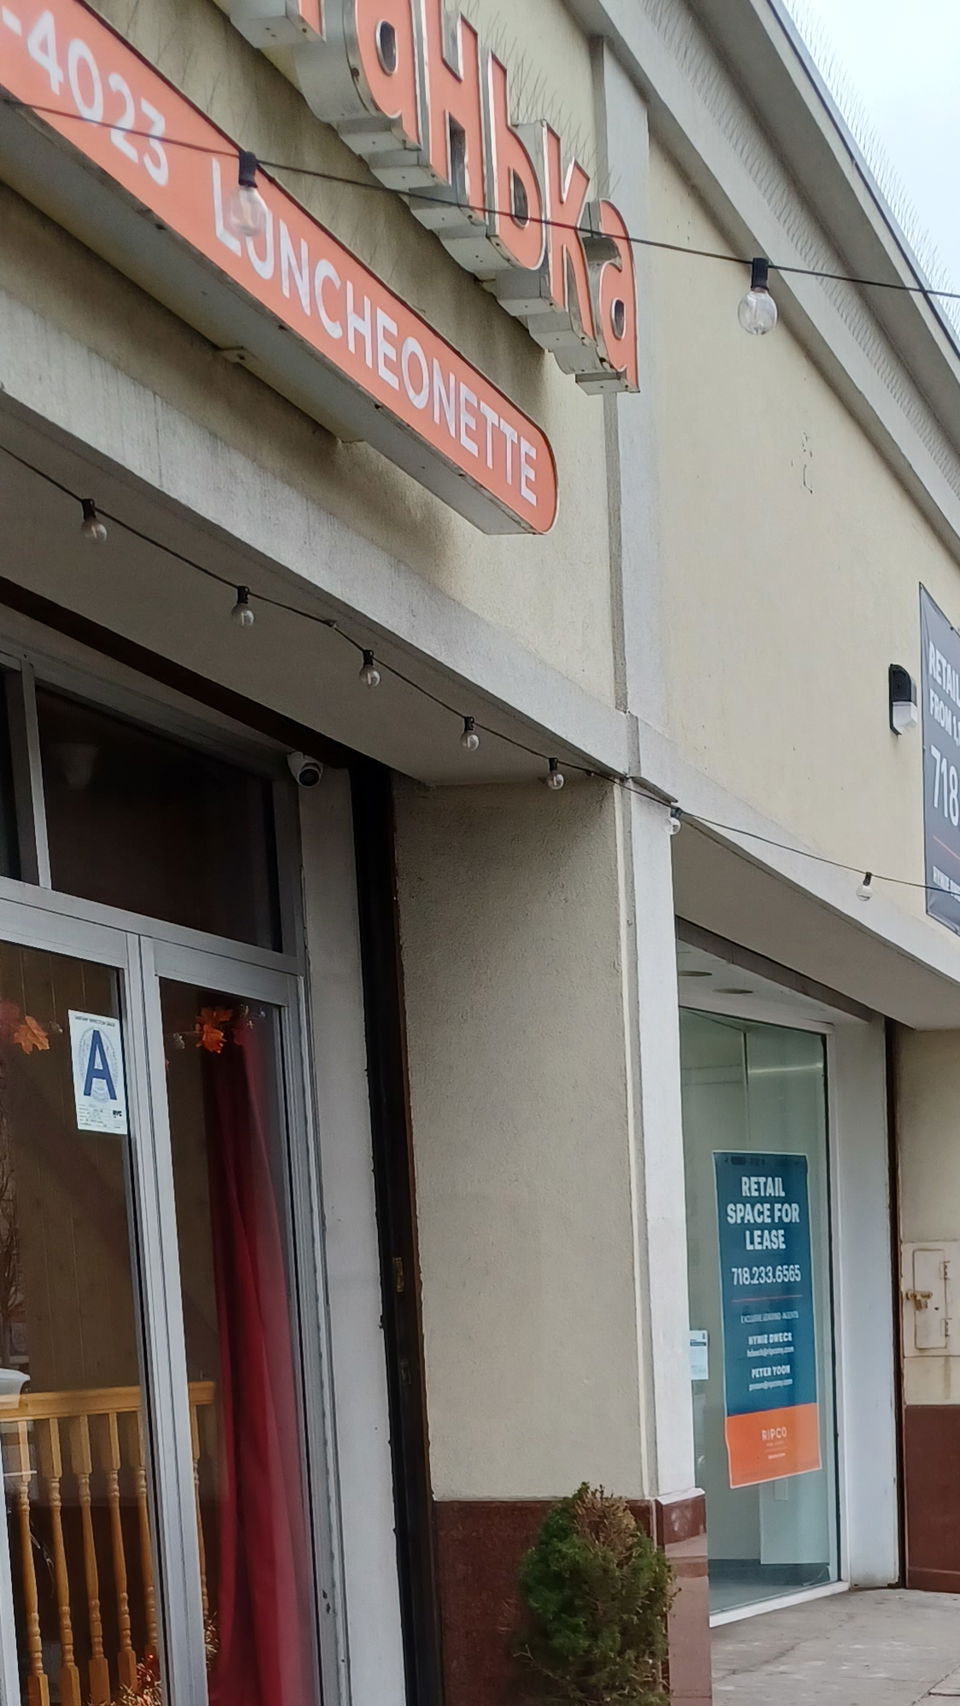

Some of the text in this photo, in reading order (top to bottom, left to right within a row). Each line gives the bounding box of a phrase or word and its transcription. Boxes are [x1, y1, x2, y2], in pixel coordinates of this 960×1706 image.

[211, 157, 538, 506] LUNCHEONETTE
[929, 640, 960, 709] RETAIL
[929, 688, 953, 737] FROM
[83, 1029, 117, 1100] A
[741, 1176, 786, 1197] RETAIL
[727, 1203, 800, 1224] SPACE FOR
[745, 1229, 786, 1251] LEASE
[731, 1264, 801, 1286] 718.233.6565
[761, 1426, 788, 1441] RIPCO
